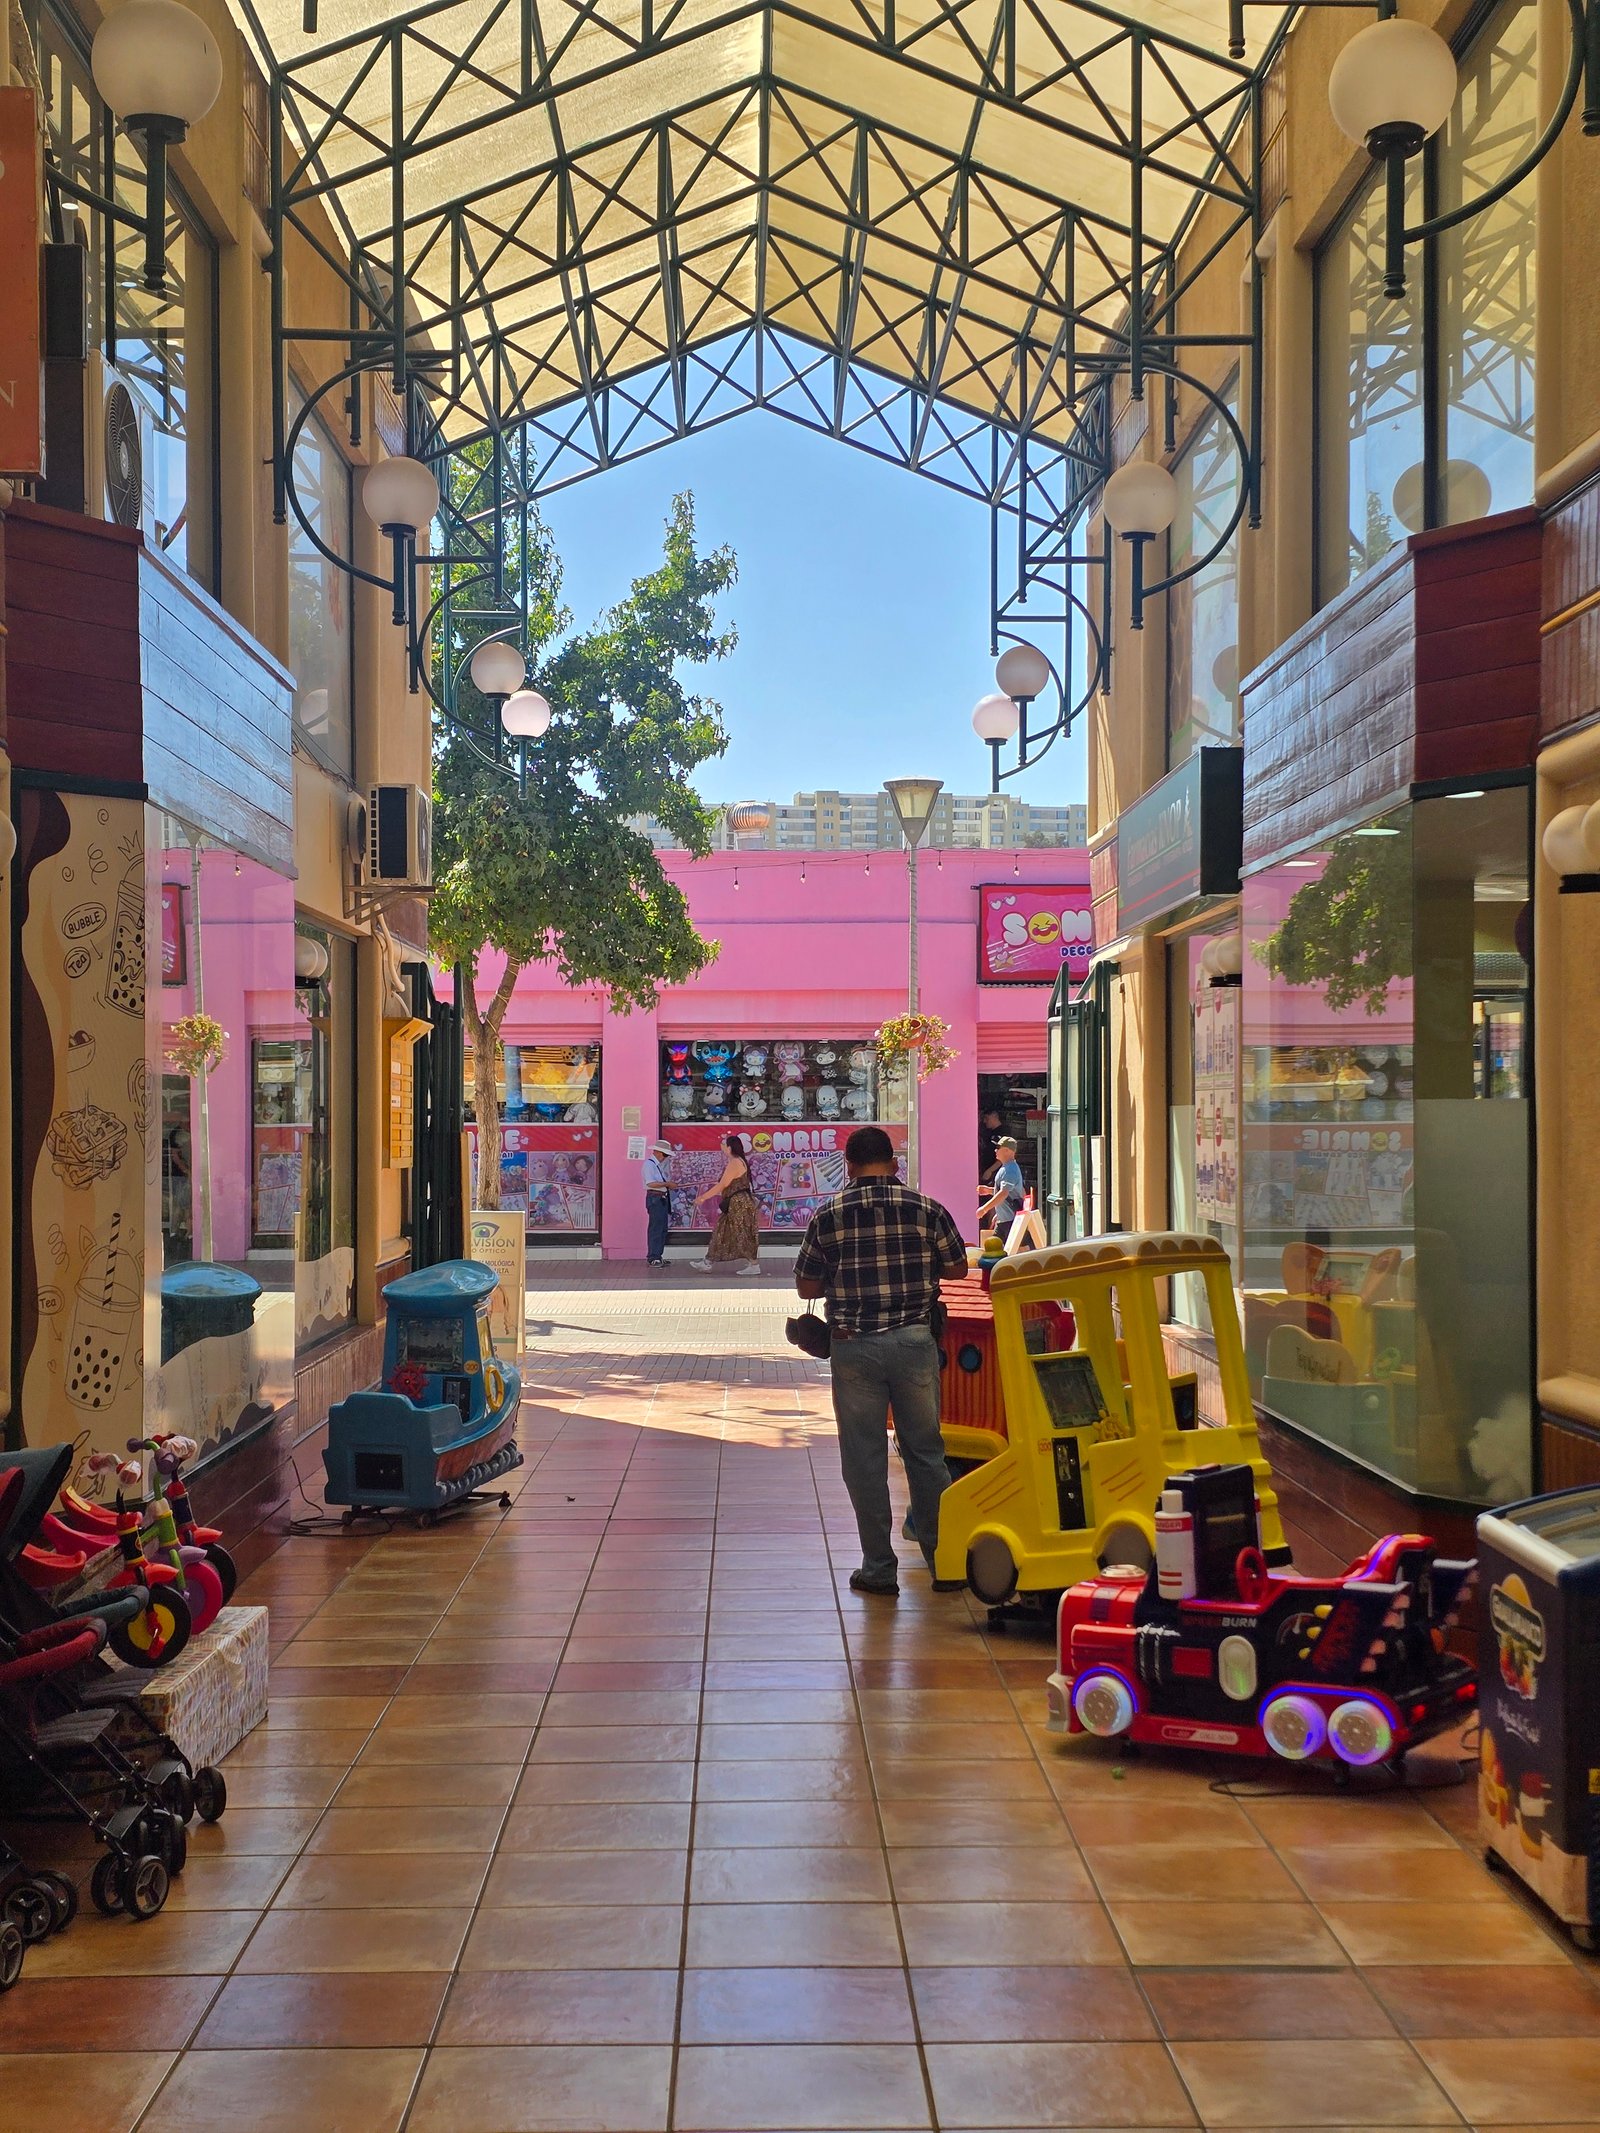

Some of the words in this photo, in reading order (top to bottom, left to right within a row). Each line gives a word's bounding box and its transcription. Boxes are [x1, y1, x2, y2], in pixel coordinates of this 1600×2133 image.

[68, 911, 101, 934] BUBBLE
[68, 954, 88, 973] Tea
[801, 1151, 830, 1159] KAWAII
[472, 1238, 515, 1247] VISION
[483, 1259, 515, 1267] MOLÓGICA
[39, 1298, 57, 1308] Tea
[1155, 1520, 1182, 1530] ANGER
